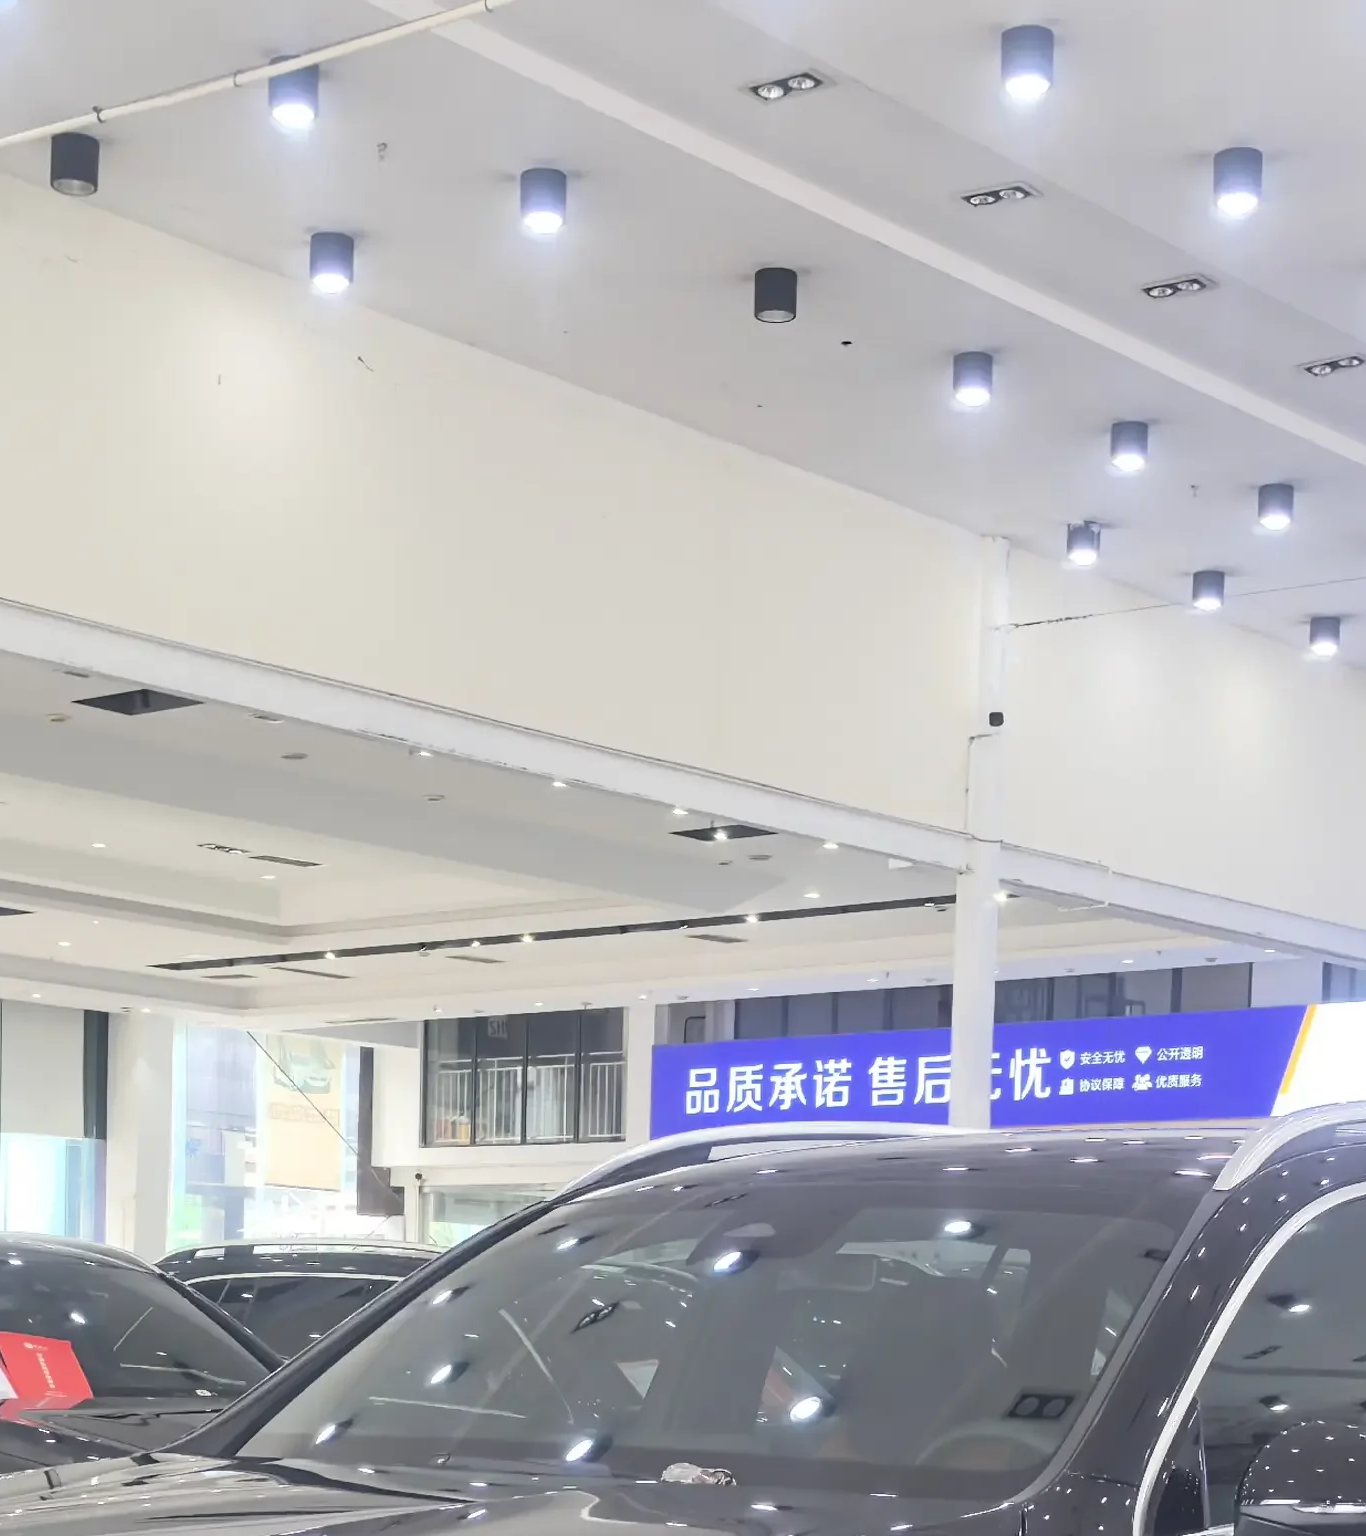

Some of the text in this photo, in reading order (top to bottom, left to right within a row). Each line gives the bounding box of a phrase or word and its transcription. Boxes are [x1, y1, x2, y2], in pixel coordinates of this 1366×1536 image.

[1157, 1046, 1204, 1061] 公开透明
[686, 1059, 852, 1115] 品质承诺
[1155, 1074, 1202, 1089] 优质服务
